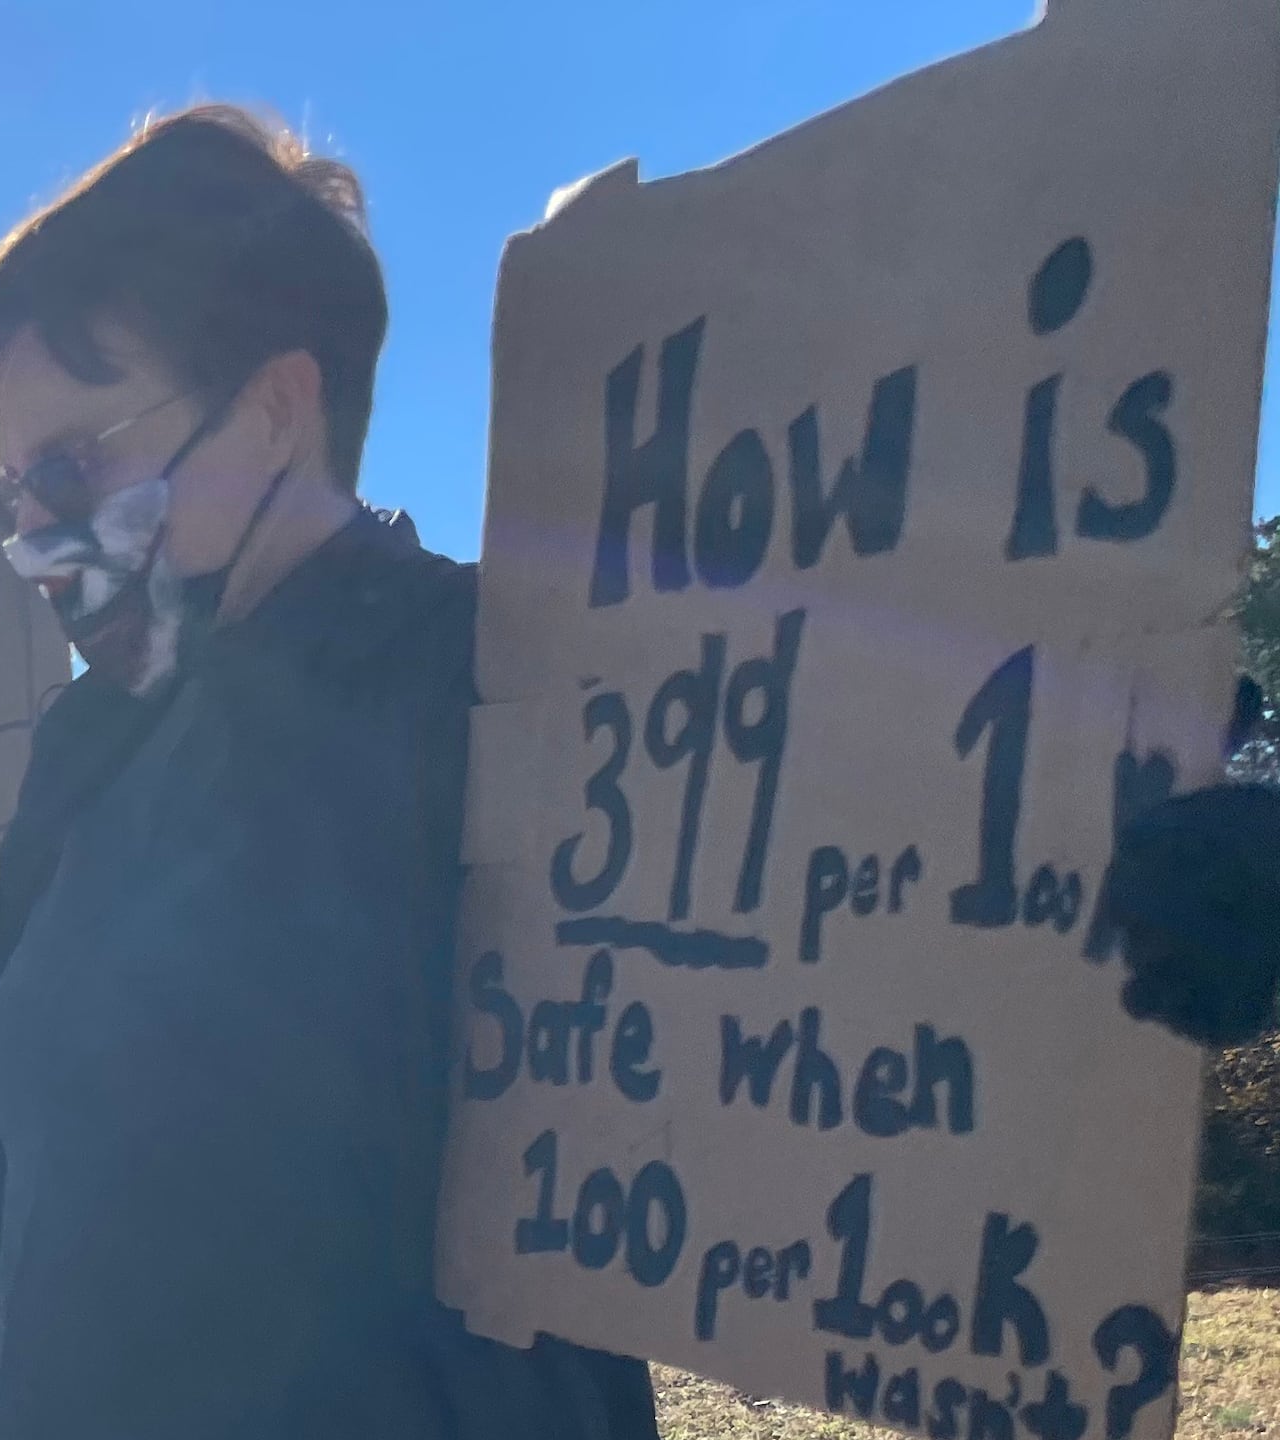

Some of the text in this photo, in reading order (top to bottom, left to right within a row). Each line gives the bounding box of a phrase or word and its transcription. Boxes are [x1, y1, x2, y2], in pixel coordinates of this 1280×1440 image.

[590, 236, 1176, 608] How is
[797, 844, 922, 964] per
[463, 948, 976, 1137] Safe when
[515, 1128, 687, 1287] 100
[694, 1237, 813, 1342] per
